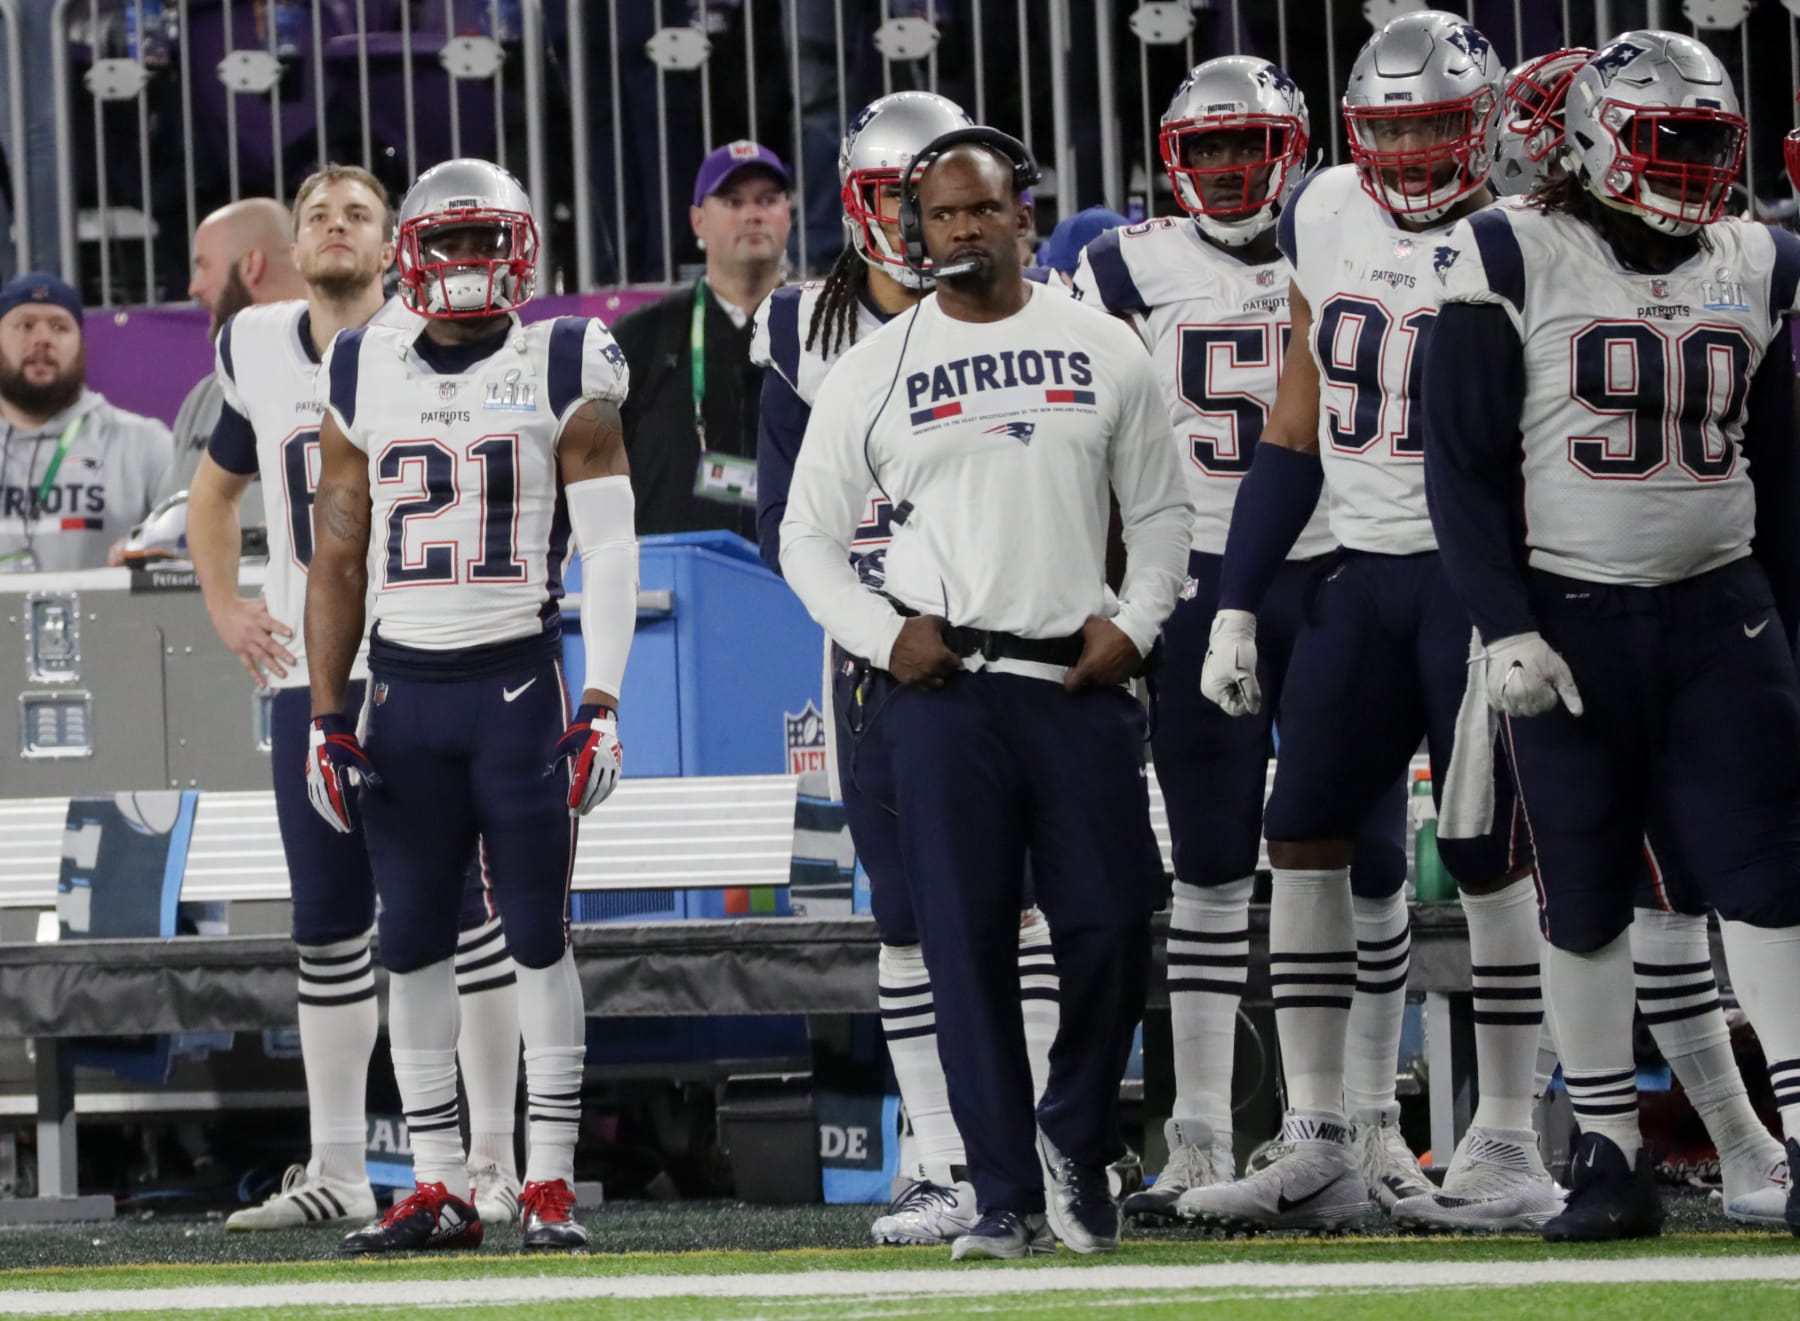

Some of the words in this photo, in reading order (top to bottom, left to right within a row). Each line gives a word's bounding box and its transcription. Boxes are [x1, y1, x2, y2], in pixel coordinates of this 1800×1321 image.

[1370, 269, 1416, 289] PATRIOTS
[1242, 297, 1291, 313] PATRIOT
[1637, 304, 1691, 319] PATRIOTS
[906, 349, 1093, 409] PATRIOTS
[1314, 292, 1438, 459] 91
[420, 410, 471, 424] PATRIOTS
[1176, 321, 1293, 479] 5
[1568, 319, 1757, 483] 90
[0, 484, 105, 518] RIOTS
[376, 433, 528, 591] 21
[1315, 1121, 1347, 1145] NIKE
